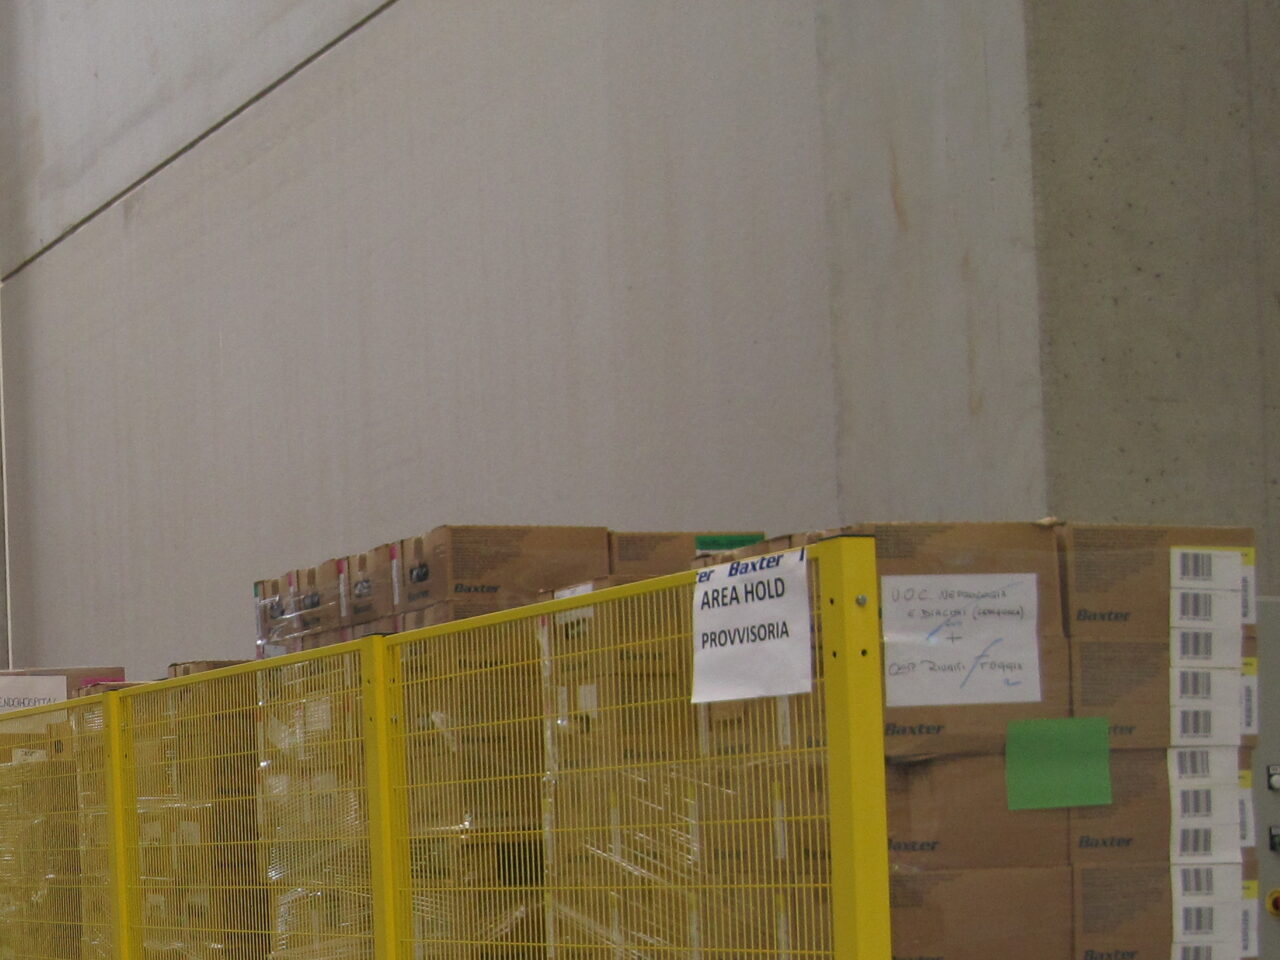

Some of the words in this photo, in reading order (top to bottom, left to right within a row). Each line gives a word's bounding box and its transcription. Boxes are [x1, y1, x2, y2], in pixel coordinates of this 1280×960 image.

[728, 554, 785, 577] Baxter
[454, 584, 501, 593] Baxter
[701, 585, 740, 610] AREA
[744, 577, 785, 603] HOLD
[1077, 609, 1131, 621] Baxter
[702, 620, 789, 650] PROVVISORIA
[885, 723, 945, 736] Baxter
[1079, 836, 1133, 849] Baxter
